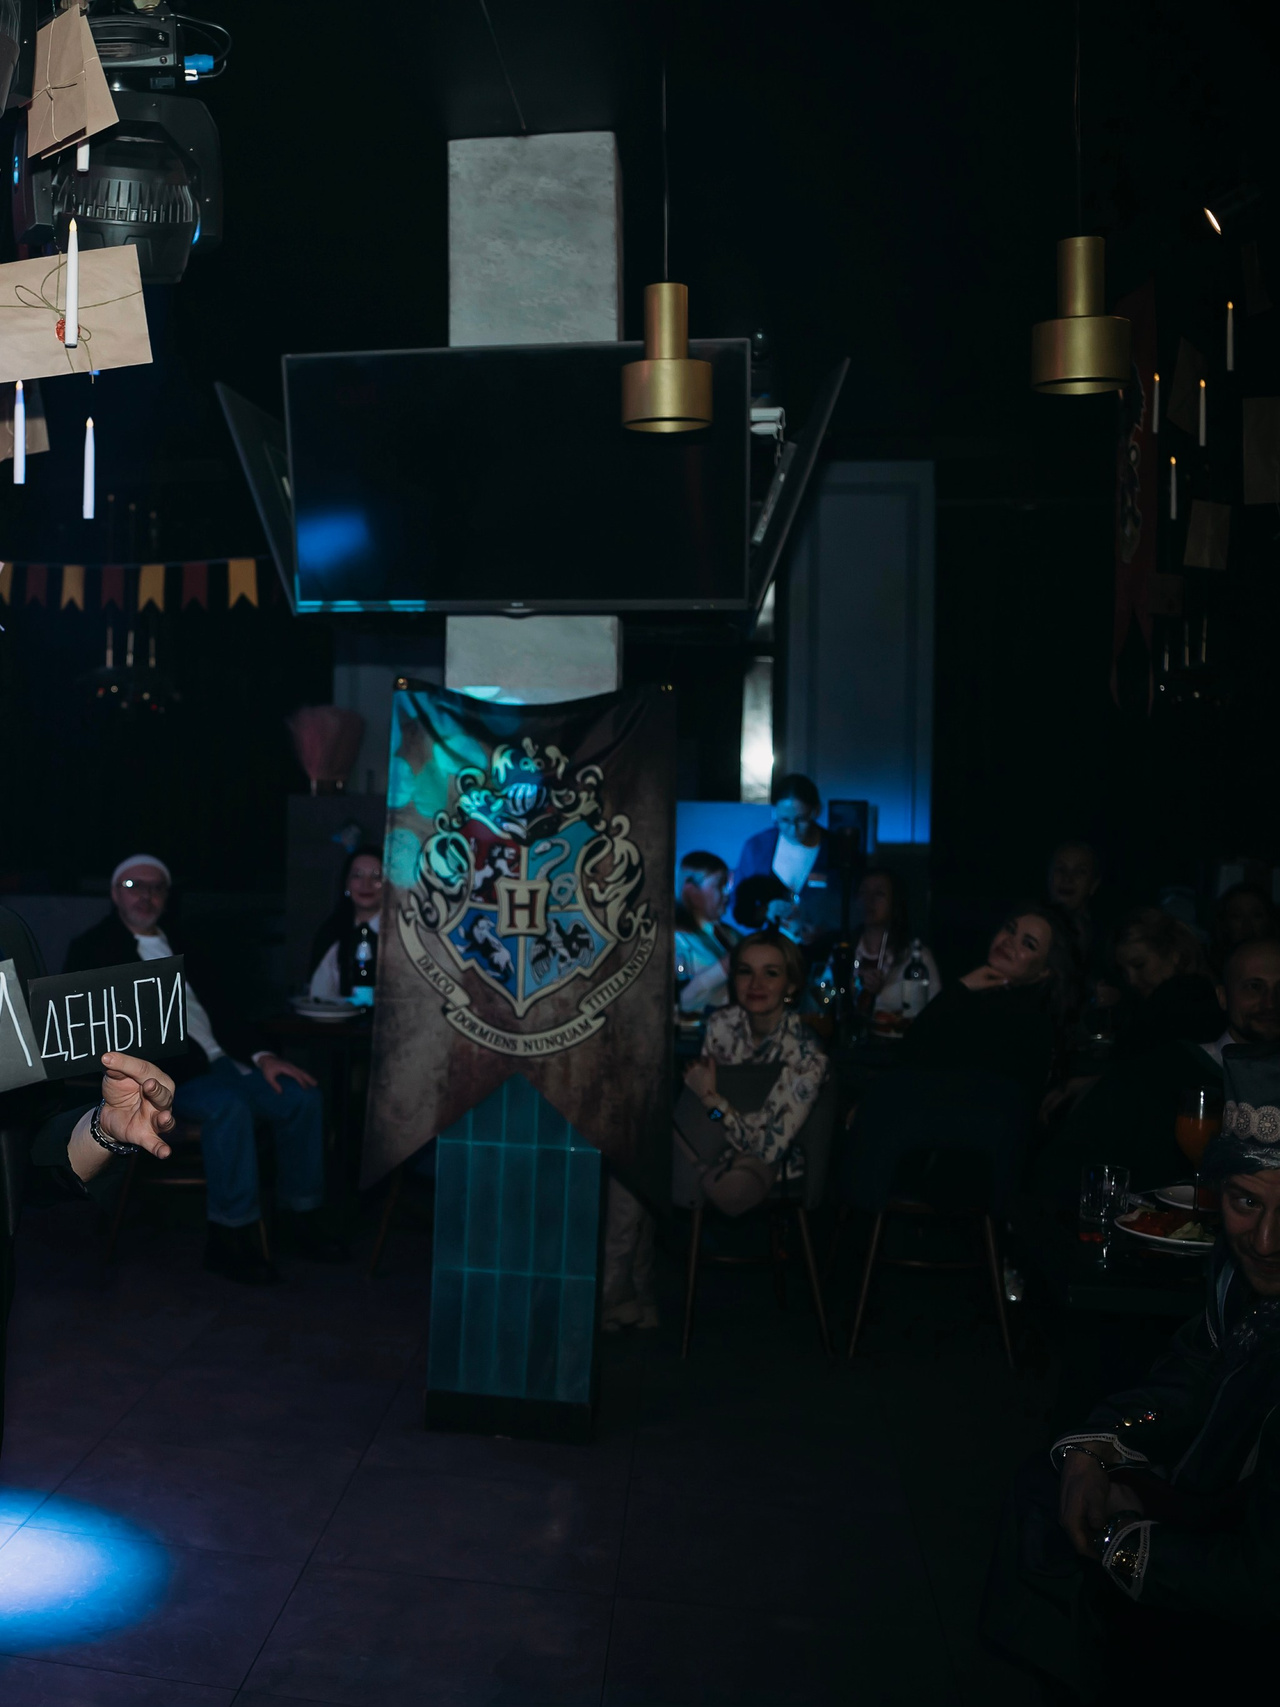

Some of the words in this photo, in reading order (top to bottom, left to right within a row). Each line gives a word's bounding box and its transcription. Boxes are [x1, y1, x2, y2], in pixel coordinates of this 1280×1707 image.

[506, 889, 538, 929] H
[40, 972, 184, 1062] ДЕНЬГИ
[417, 955, 454, 995] DRACO
[455, 1012, 518, 1050] DORMIENS
[523, 1020, 592, 1052] NUNQUAM
[587, 939, 653, 1010] TITILLANDUS
